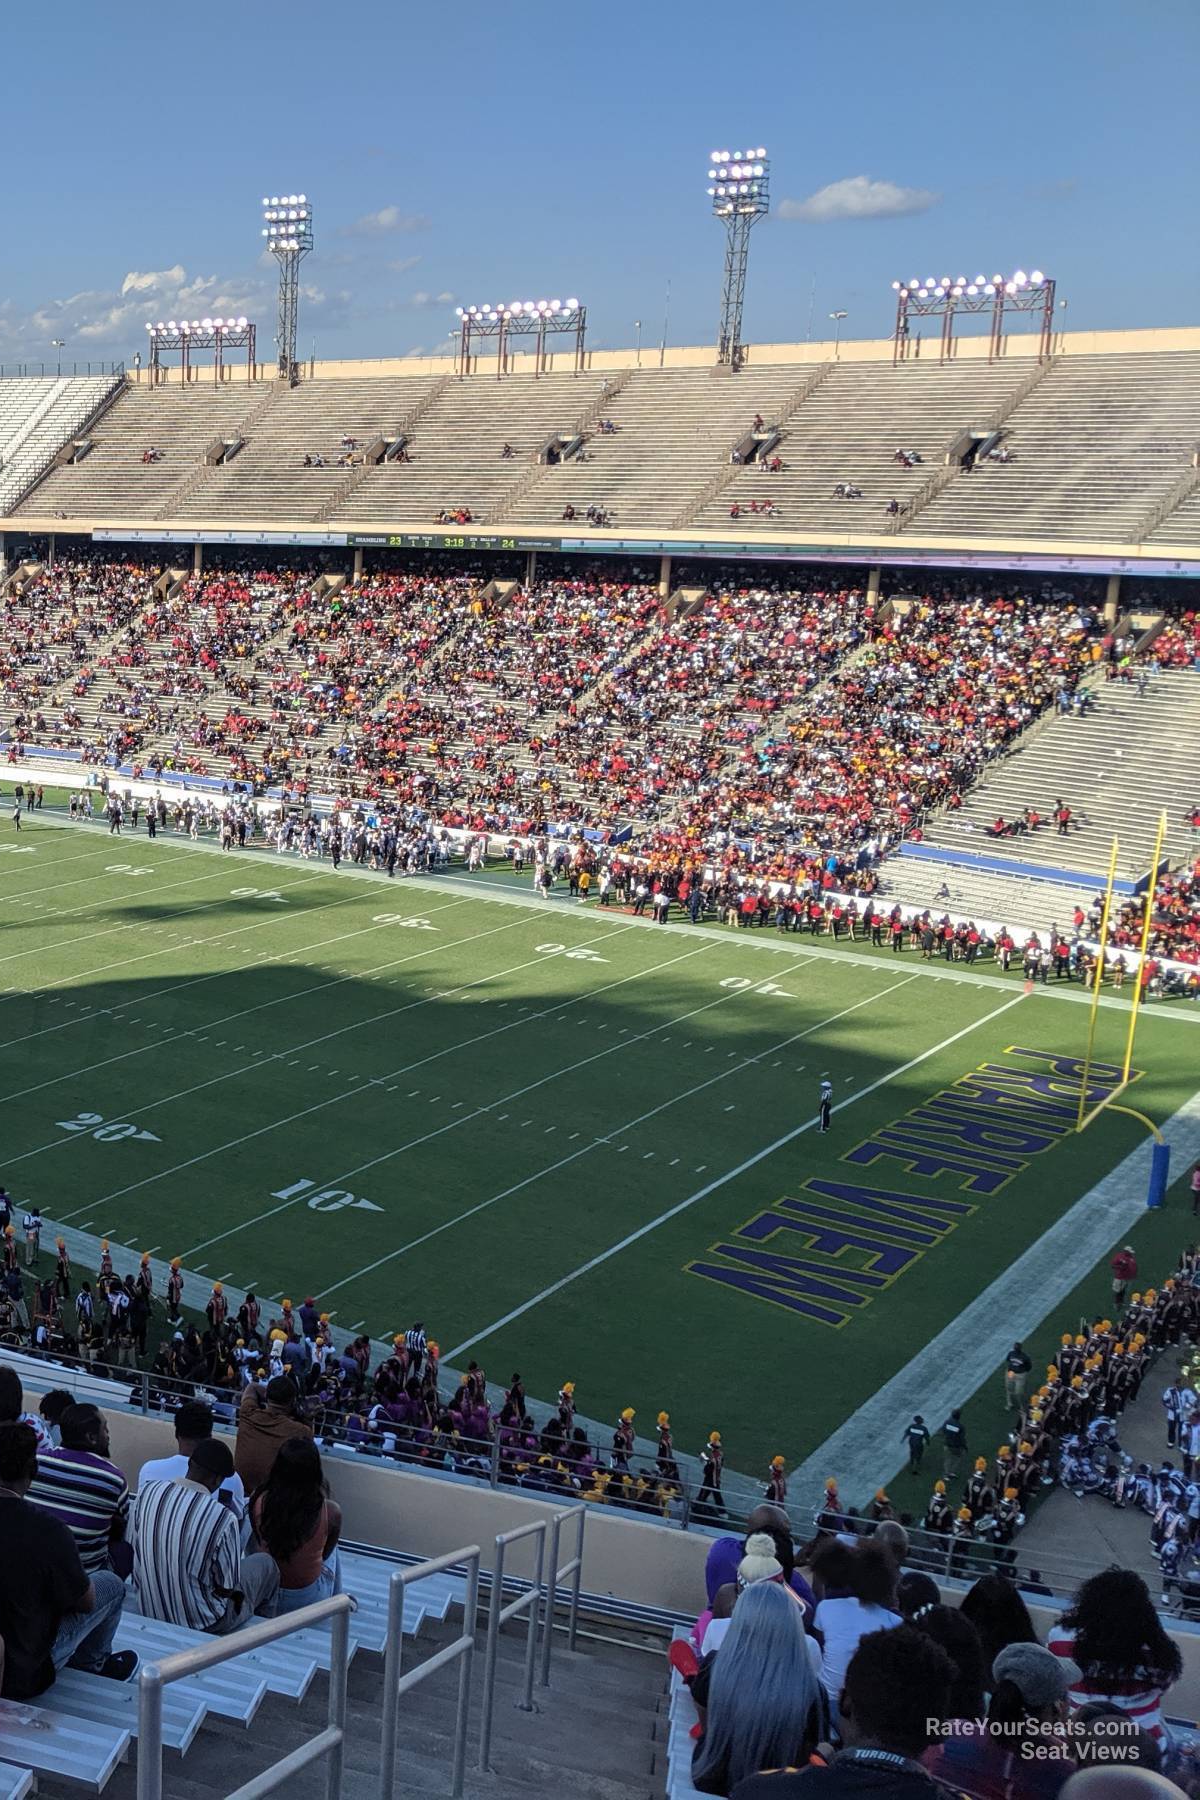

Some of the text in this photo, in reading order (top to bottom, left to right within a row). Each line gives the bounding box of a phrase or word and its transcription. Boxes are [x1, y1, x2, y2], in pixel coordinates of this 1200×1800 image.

[390, 536, 401, 545] 23
[444, 538, 464, 547] 3:18
[502, 539, 514, 549] 24
[104, 864, 155, 877] 50
[371, 913, 432, 929] 30
[533, 943, 601, 961] 20
[719, 977, 788, 997] 10
[55, 1112, 137, 1142] 20
[270, 1178, 355, 1212] 10
[684, 1045, 1146, 1329] PRAIRIE VIEW
[855, 1749, 906, 1766] TURBINE
